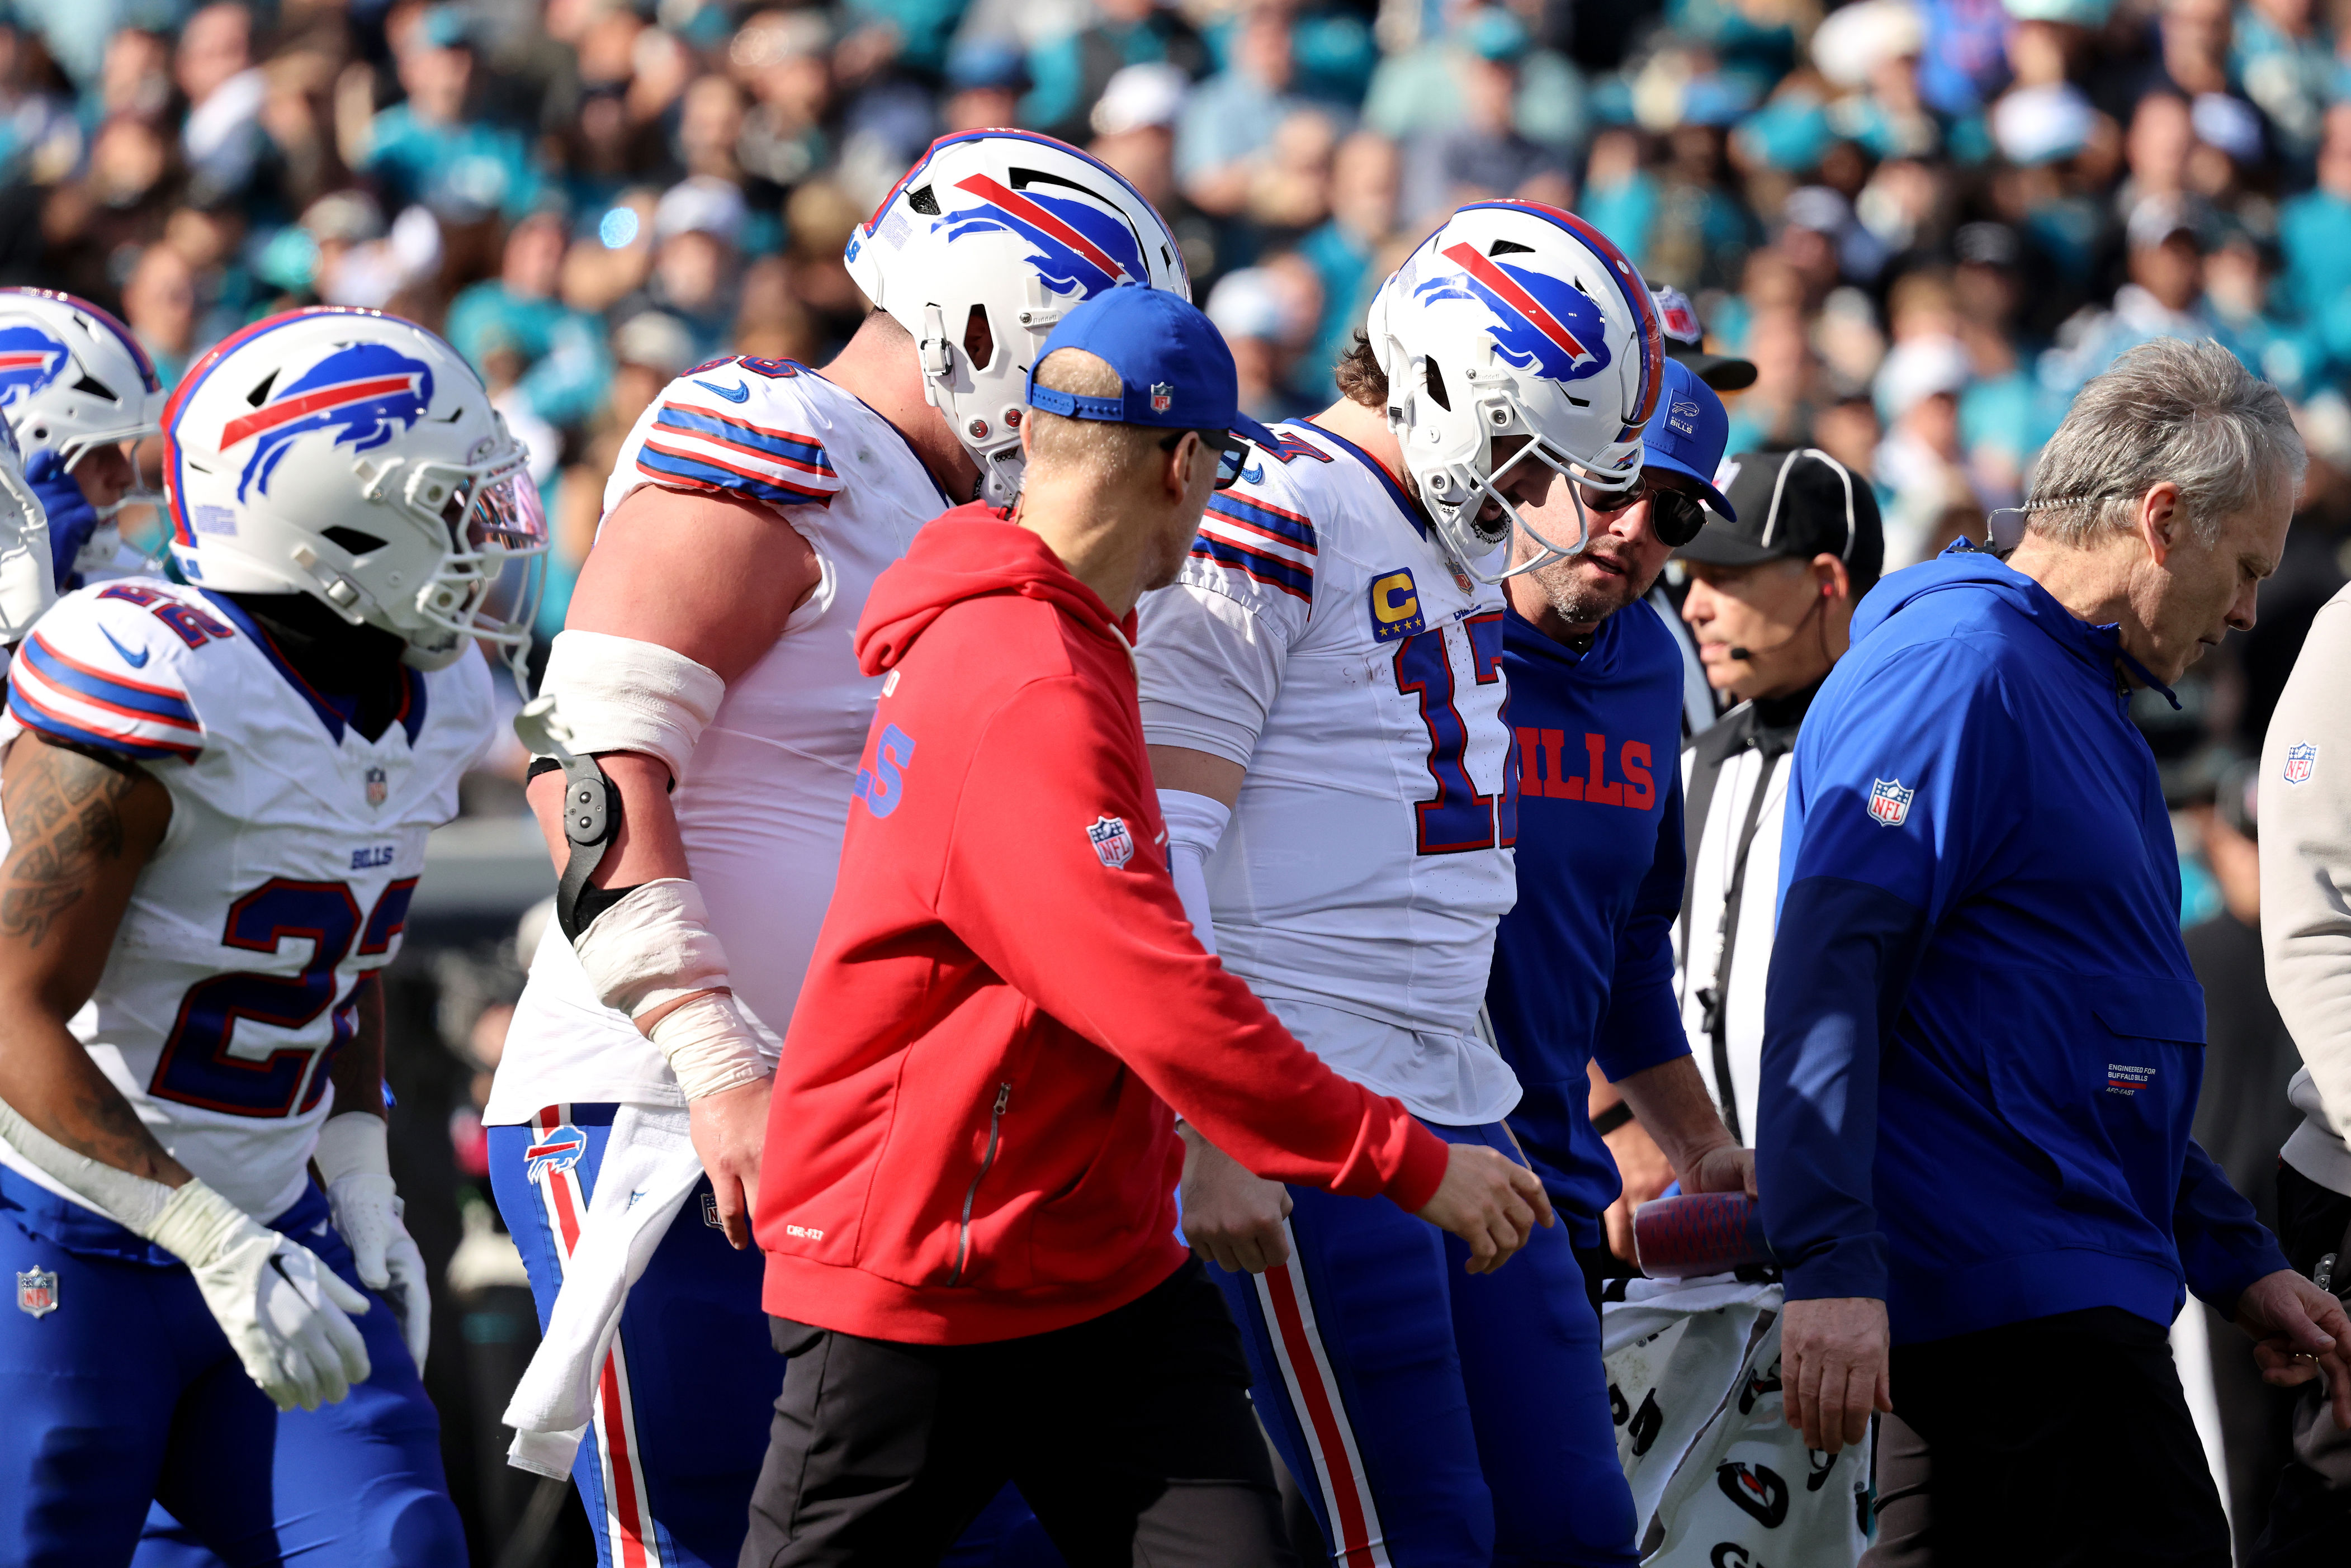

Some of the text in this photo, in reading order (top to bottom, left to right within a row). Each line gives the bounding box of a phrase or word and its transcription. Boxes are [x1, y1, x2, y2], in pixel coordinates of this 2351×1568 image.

[1033, 315, 1057, 324] Riddell
[1670, 419, 1692, 434] BILLS
[1671, 416, 1693, 428] BUFFALO
[1372, 574, 1417, 624] C
[1516, 727, 1655, 811] ILLS
[2286, 761, 2309, 779] NFL
[1872, 797, 1900, 820] NFL
[1098, 837, 1130, 860] NFL
[2108, 1064, 2143, 1073] ENGINEERED
[2108, 1072, 2134, 1081] BUFFALO
[2106, 1087, 2135, 1096] AFC-EAST
[787, 1224, 824, 1242] DRI-FIT
